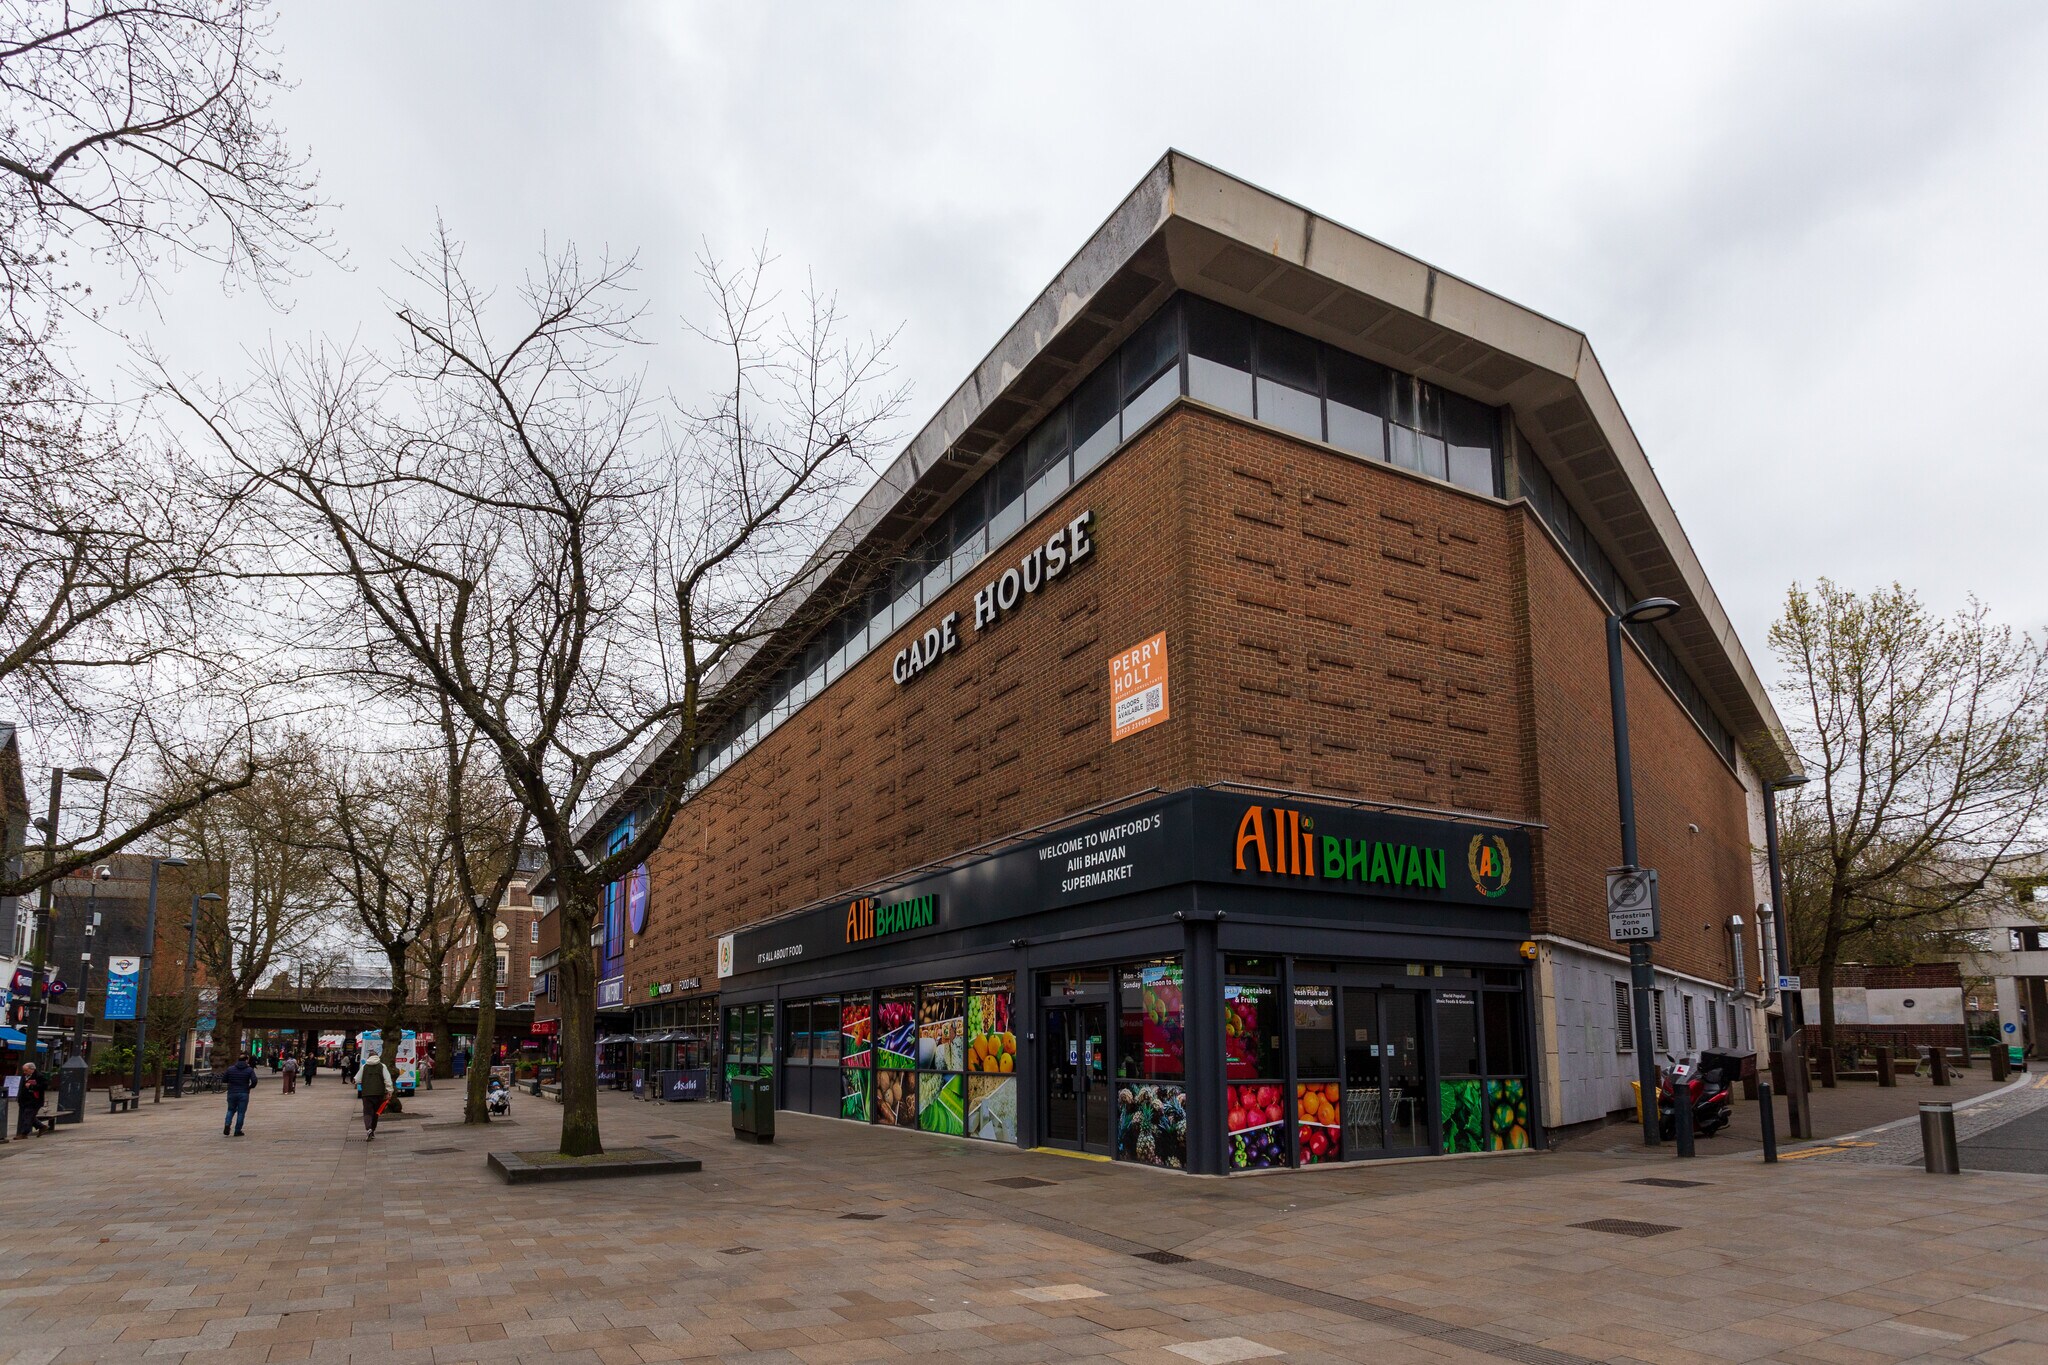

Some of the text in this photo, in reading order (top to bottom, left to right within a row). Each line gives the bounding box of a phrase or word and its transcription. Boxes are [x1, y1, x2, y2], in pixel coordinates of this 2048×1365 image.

[892, 510, 1091, 685] GADE HOUSE
[1113, 638, 1161, 676] PERRY
[1114, 662, 1151, 694] HOLT
[1117, 703, 1144, 720] AVAILABLE
[1121, 697, 1140, 711] FLOORS
[1115, 725, 1131, 737] 01923
[1039, 814, 1161, 860] WELCOME TO WATFORD'S
[1236, 805, 1447, 889] Alli BHAVAN
[1067, 845, 1126, 872] Alli BHAVAN
[1480, 845, 1501, 878] AB
[1062, 864, 1134, 893] SUPERMARKET
[846, 893, 934, 944] Alli BHAVAN
[1611, 912, 1650, 920] Pedestrian
[1615, 926, 1649, 937] ENDS
[757, 944, 803, 964] IT'S ALL ABOUT FOOD
[679, 977, 700, 990] FOOD HALL
[1123, 972, 1134, 980] Mon
[1123, 981, 1141, 989] Sunday
[1238, 986, 1271, 995] Vegetables
[301, 1003, 374, 1014] Watford Market
[673, 1079, 697, 1091] Asahi
